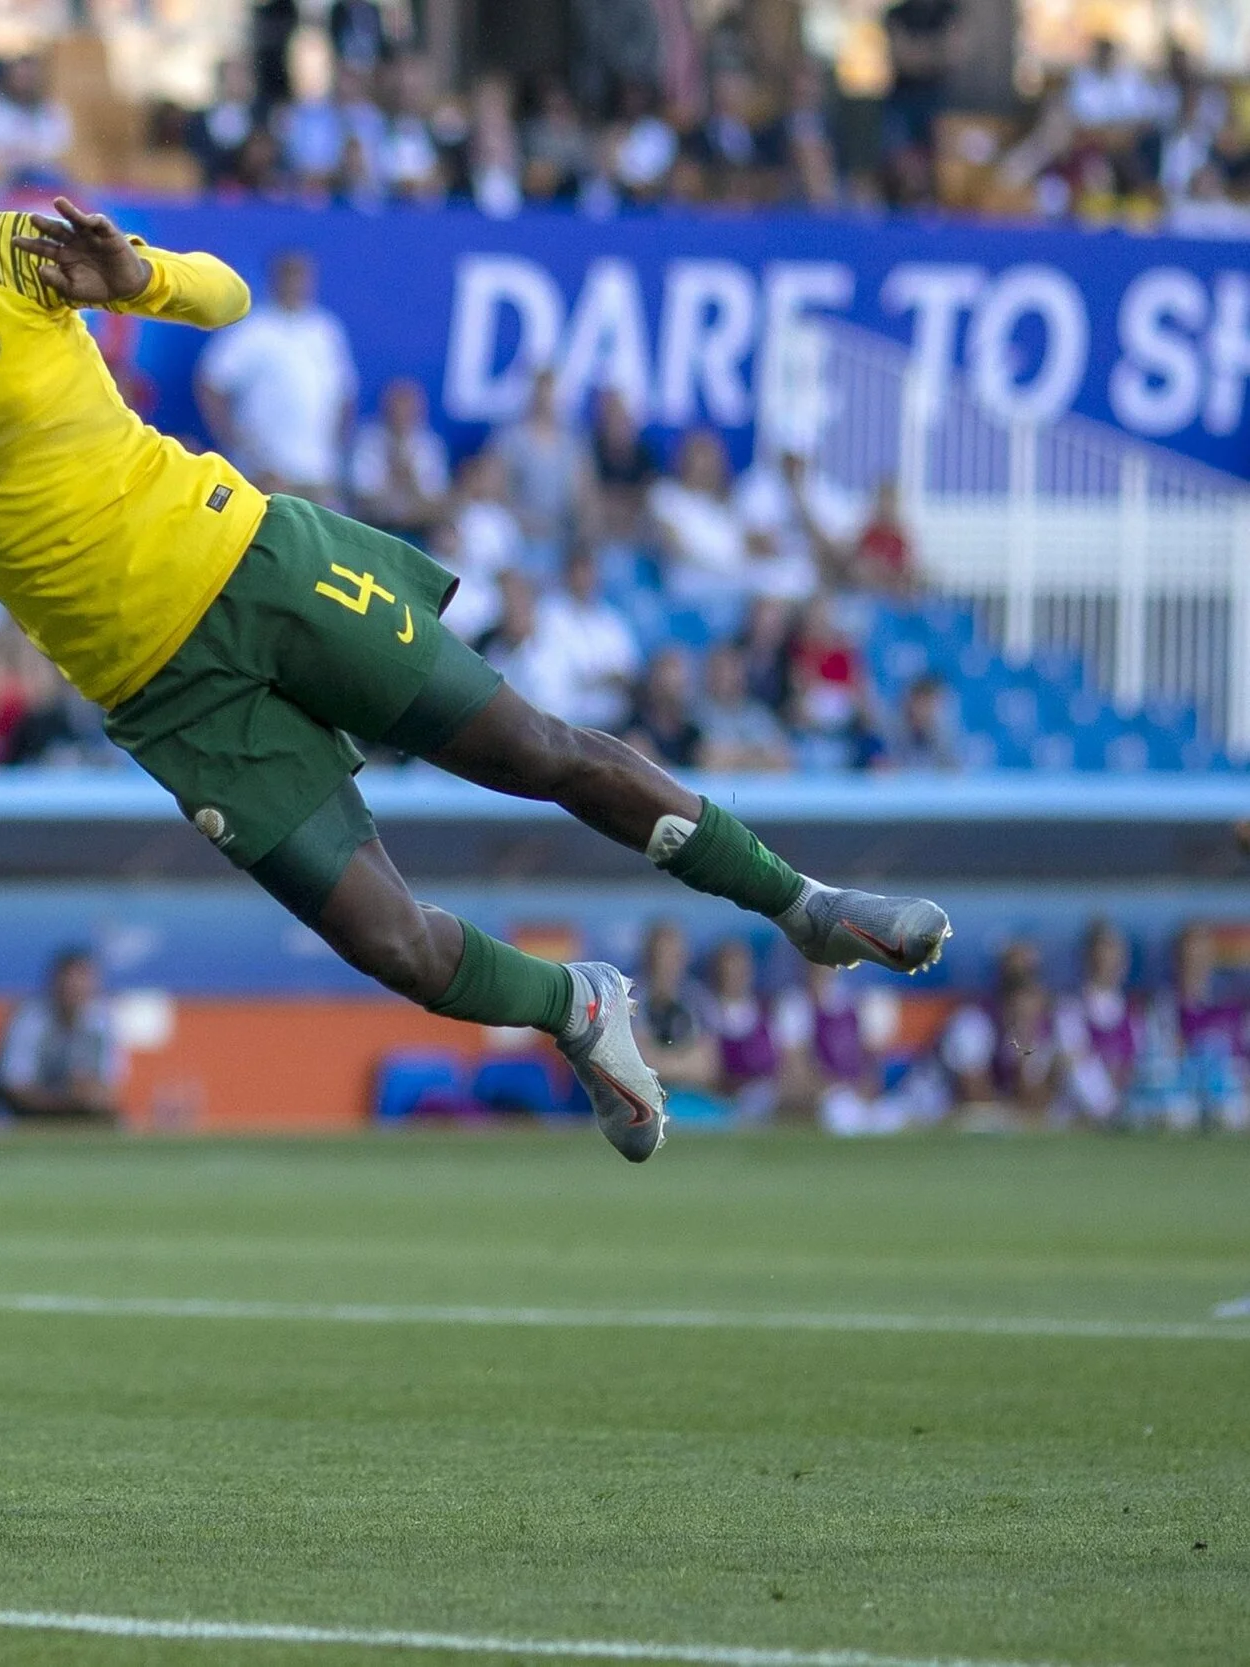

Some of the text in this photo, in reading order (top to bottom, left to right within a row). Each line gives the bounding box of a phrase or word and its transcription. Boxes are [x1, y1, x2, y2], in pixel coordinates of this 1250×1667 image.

[443, 252, 856, 428] DARE
[880, 262, 1090, 428] TO
[315, 563, 395, 615] 4
